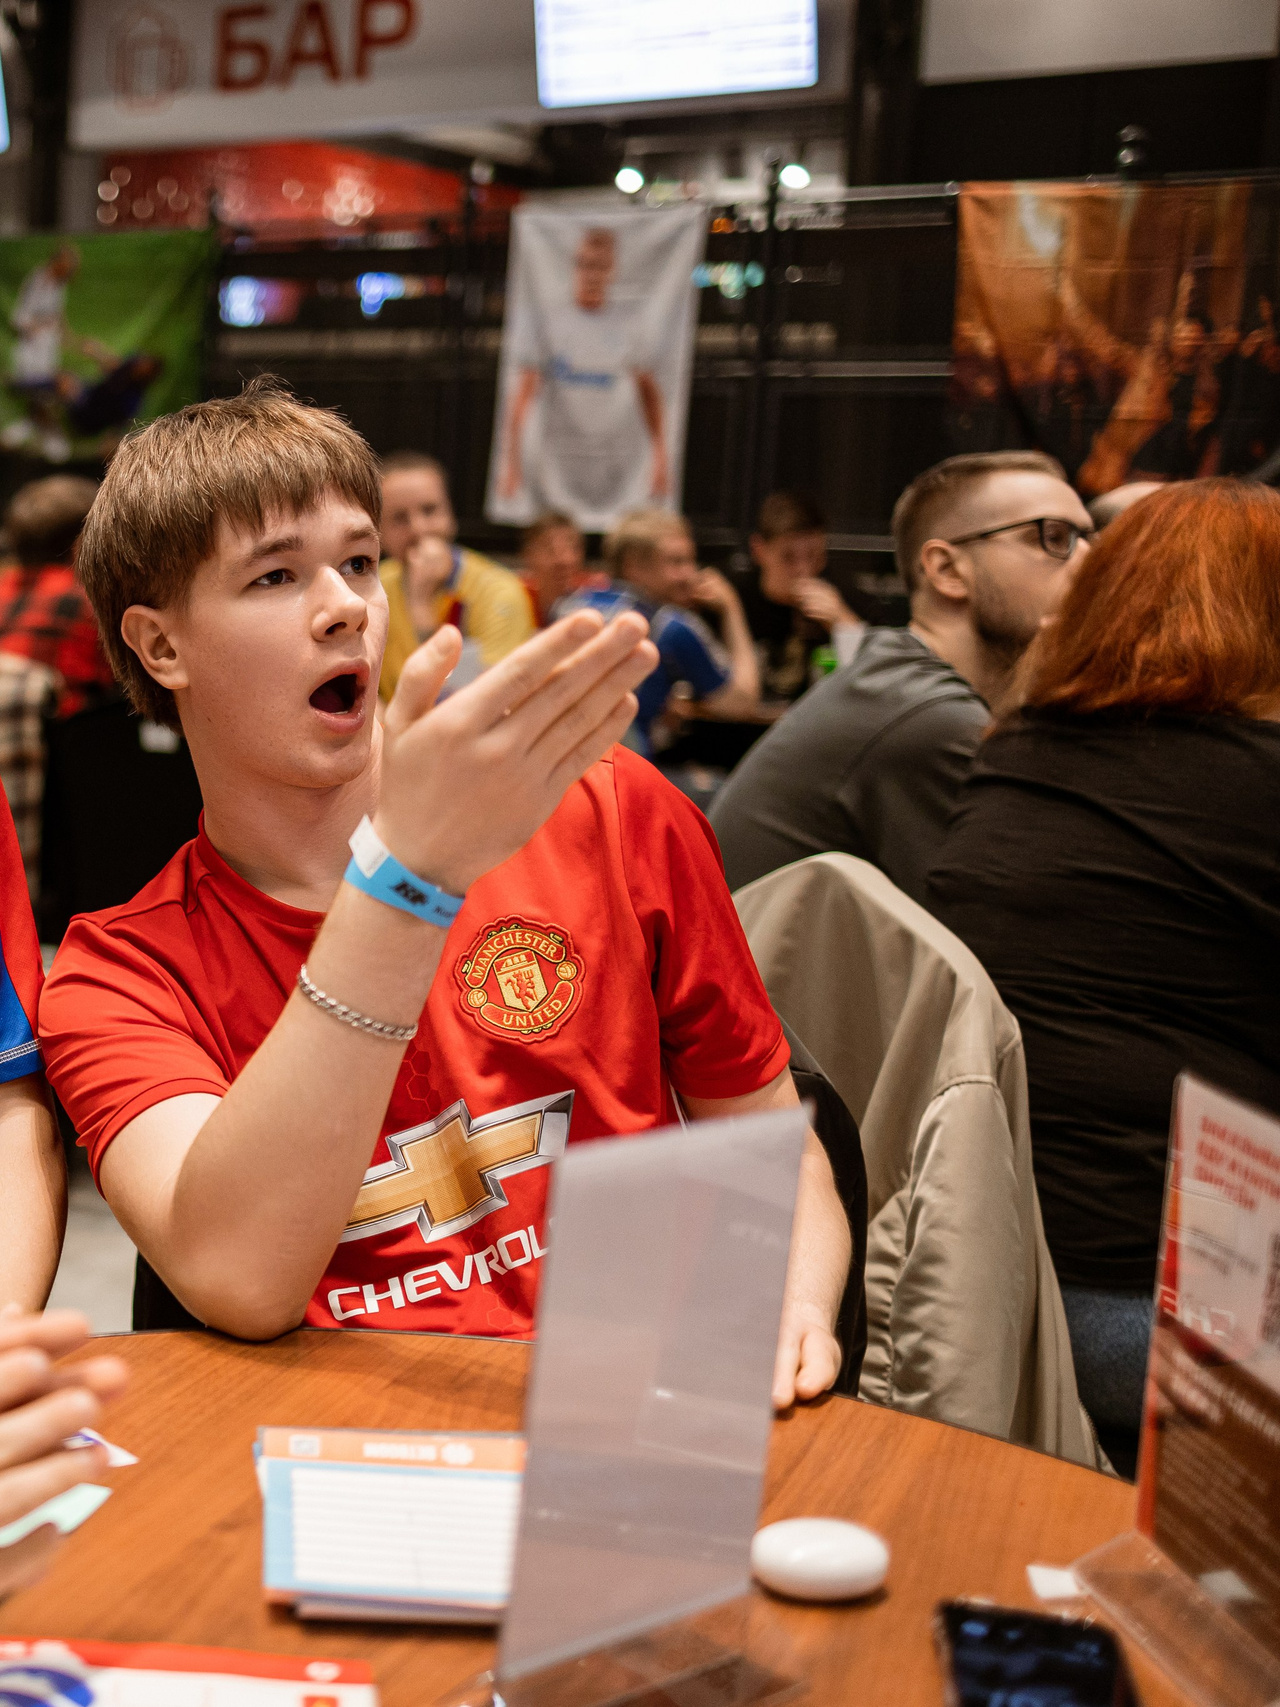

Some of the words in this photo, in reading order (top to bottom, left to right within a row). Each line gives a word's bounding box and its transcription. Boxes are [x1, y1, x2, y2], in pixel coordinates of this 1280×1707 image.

[214, 0, 421, 92] БАР
[472, 932, 558, 979] MANCHESTER
[502, 999, 562, 1027] UNITED
[327, 1224, 550, 1321] CHEVROL
